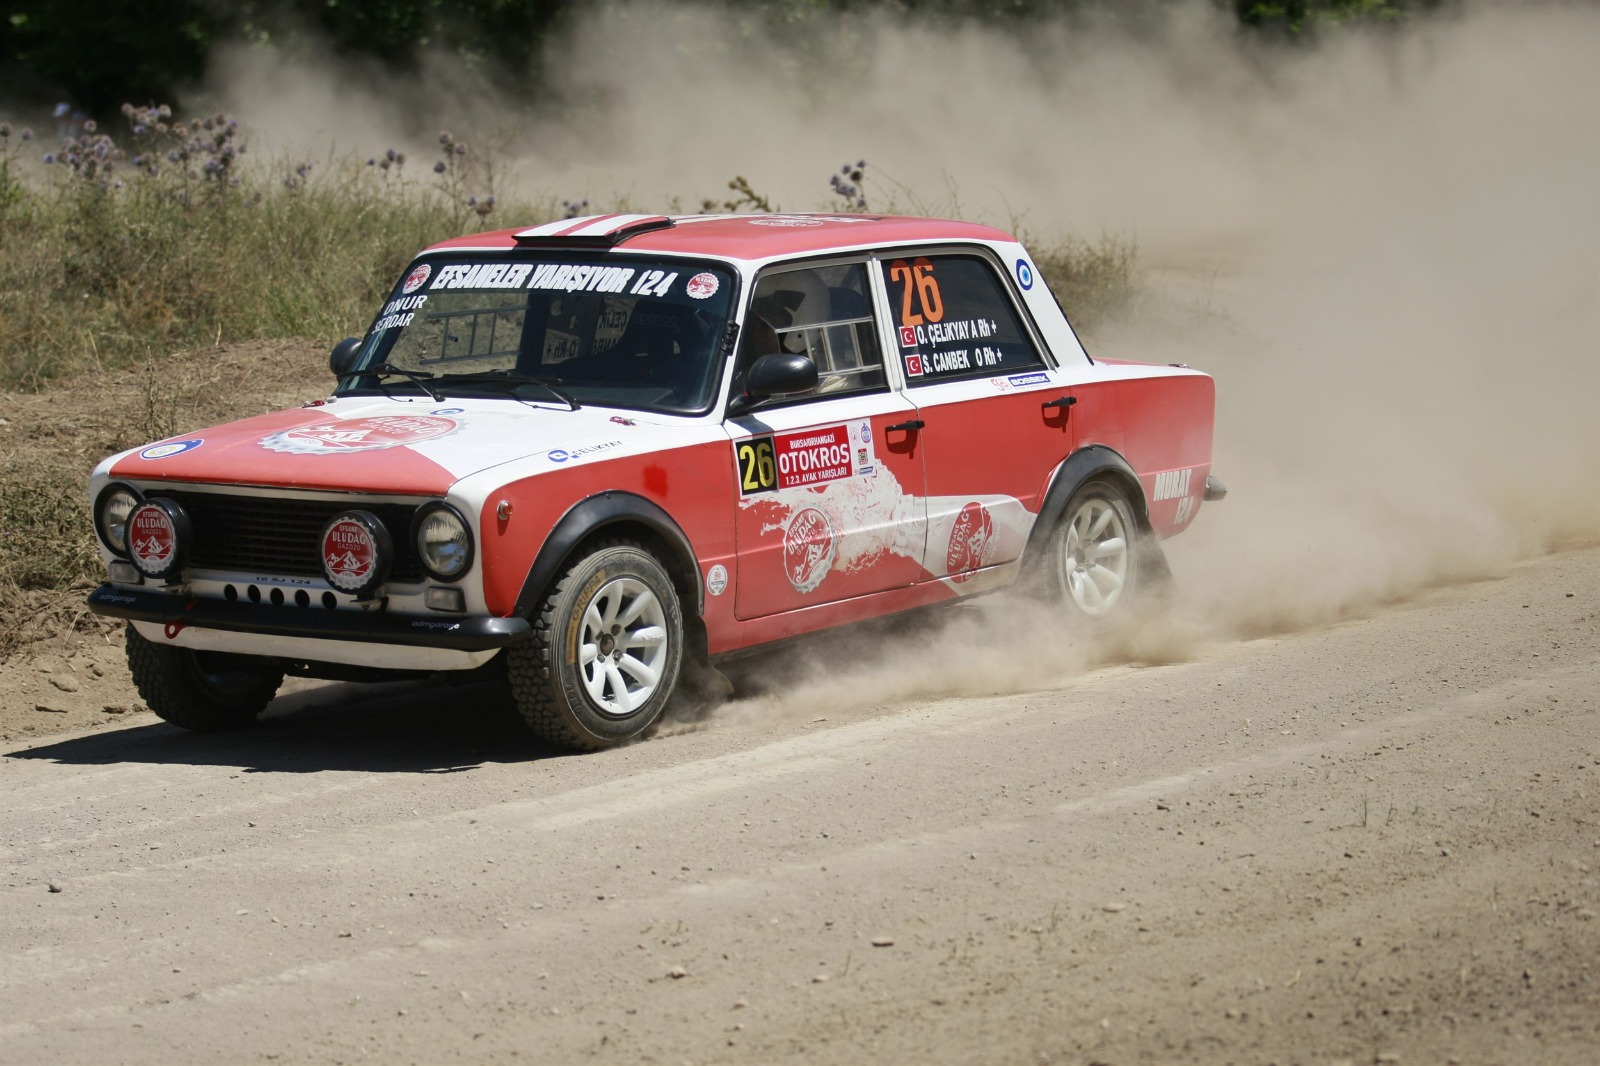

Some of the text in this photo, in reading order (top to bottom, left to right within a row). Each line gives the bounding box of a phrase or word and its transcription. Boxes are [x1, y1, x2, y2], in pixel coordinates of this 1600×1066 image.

[429, 264, 534, 290] EFSANELER
[526, 264, 635, 293] YARIŞIYOR
[629, 269, 679, 297] 124
[890, 257, 944, 327] 26
[383, 295, 428, 316] ONUR
[371, 312, 415, 334] SERDAR
[917, 327, 928, 345] O.
[971, 323, 979, 339] A
[977, 319, 991, 338] Rh
[991, 320, 997, 334] +
[922, 355, 933, 374] S.
[932, 350, 971, 372] CANBEK
[983, 347, 997, 365] Rh
[997, 348, 1002, 362] +
[739, 442, 775, 491] 26
[779, 443, 850, 474] OTOKROS
[785, 473, 801, 485] 1.2.3.
[802, 471, 818, 483] AYAK
[817, 466, 847, 481] YARIŞLARI
[1153, 468, 1192, 502] MURAT
[1173, 495, 1195, 526] 124
[339, 525, 358, 533] EFSANE
[788, 513, 805, 538] EFSANE
[949, 524, 960, 552] EFSANE
[337, 543, 361, 551] GAZOZU
[411, 621, 460, 631] admgarage
